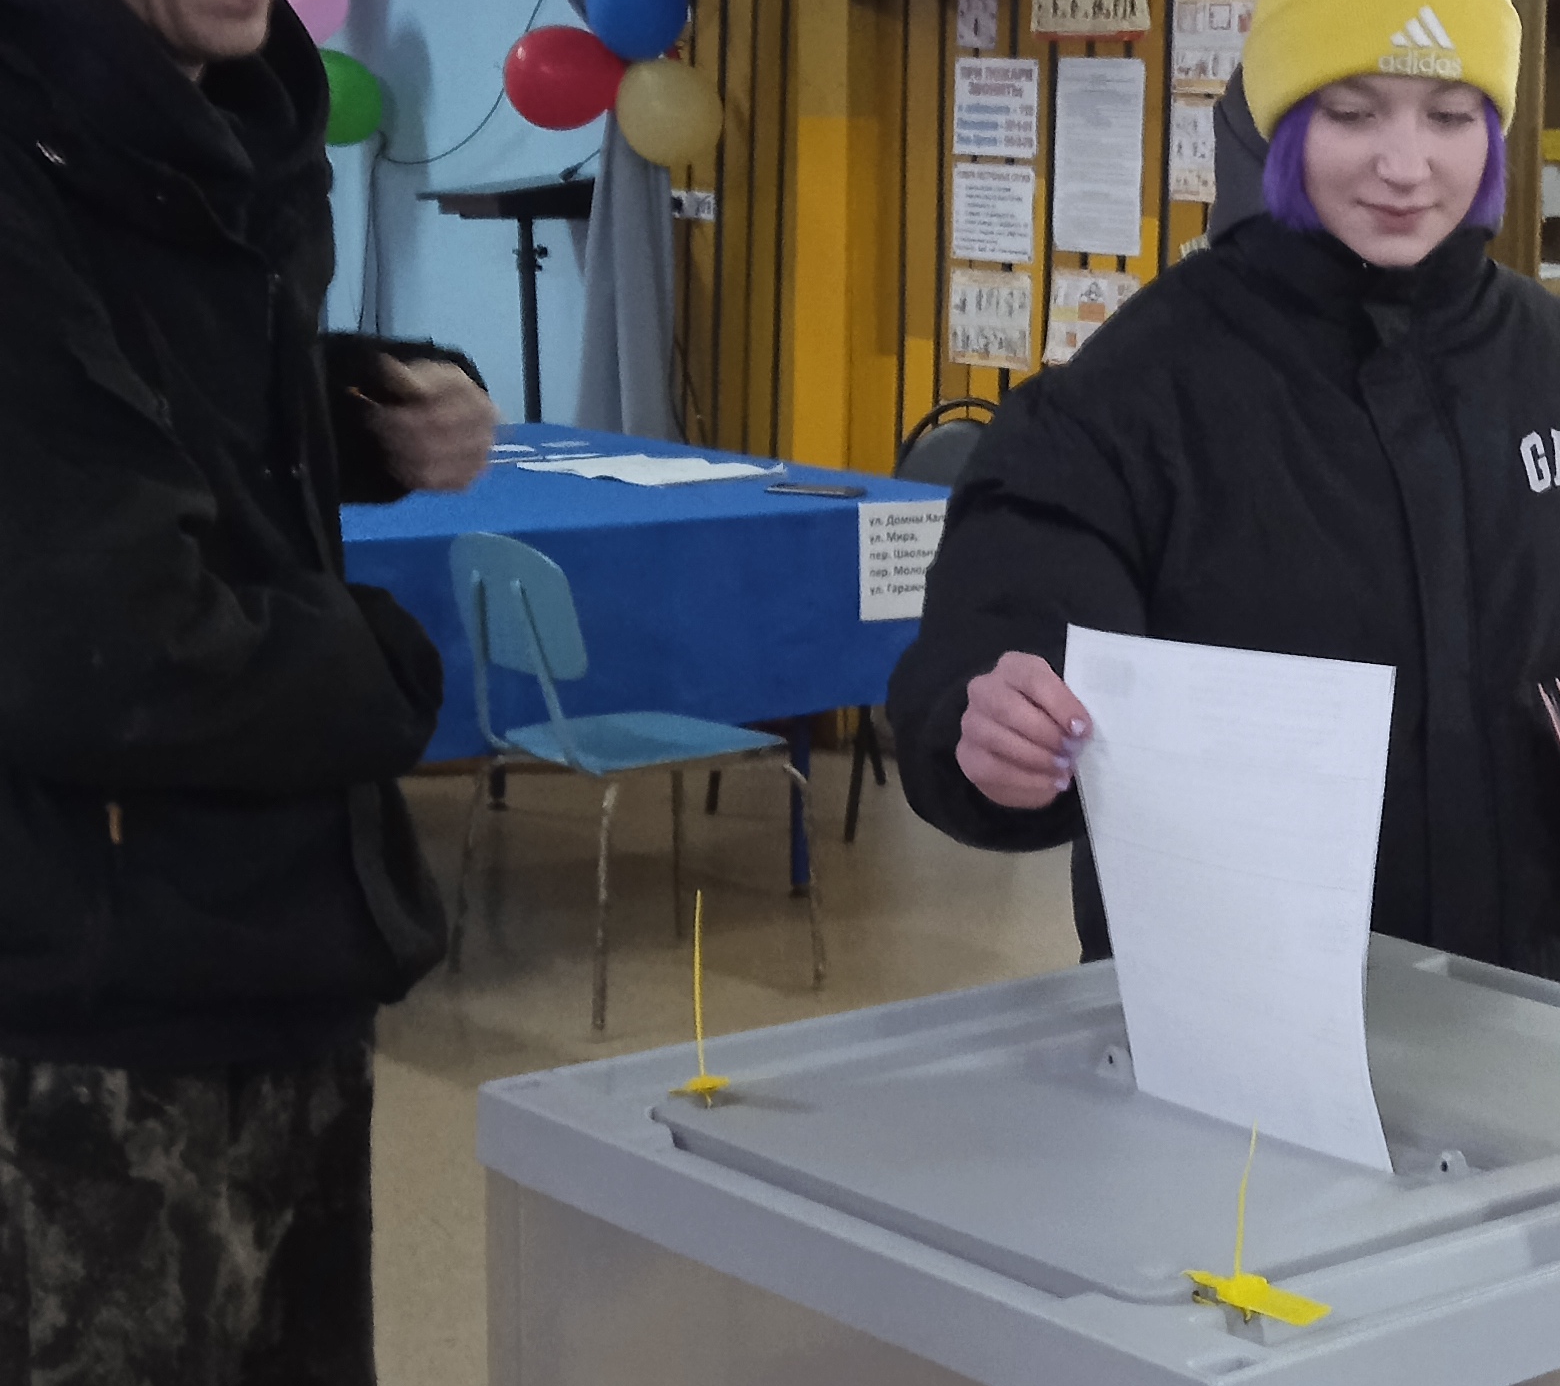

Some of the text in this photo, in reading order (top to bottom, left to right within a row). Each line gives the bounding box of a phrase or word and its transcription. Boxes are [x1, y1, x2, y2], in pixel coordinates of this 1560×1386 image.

[1378, 50, 1462, 80] adidas
[869, 517, 883, 527] ул.
[885, 514, 923, 527] Домны
[869, 532, 918, 544] ул. Мира,
[869, 549, 935, 561] пер. Школьн
[869, 569, 890, 579] пер.
[869, 587, 884, 596] ул.
